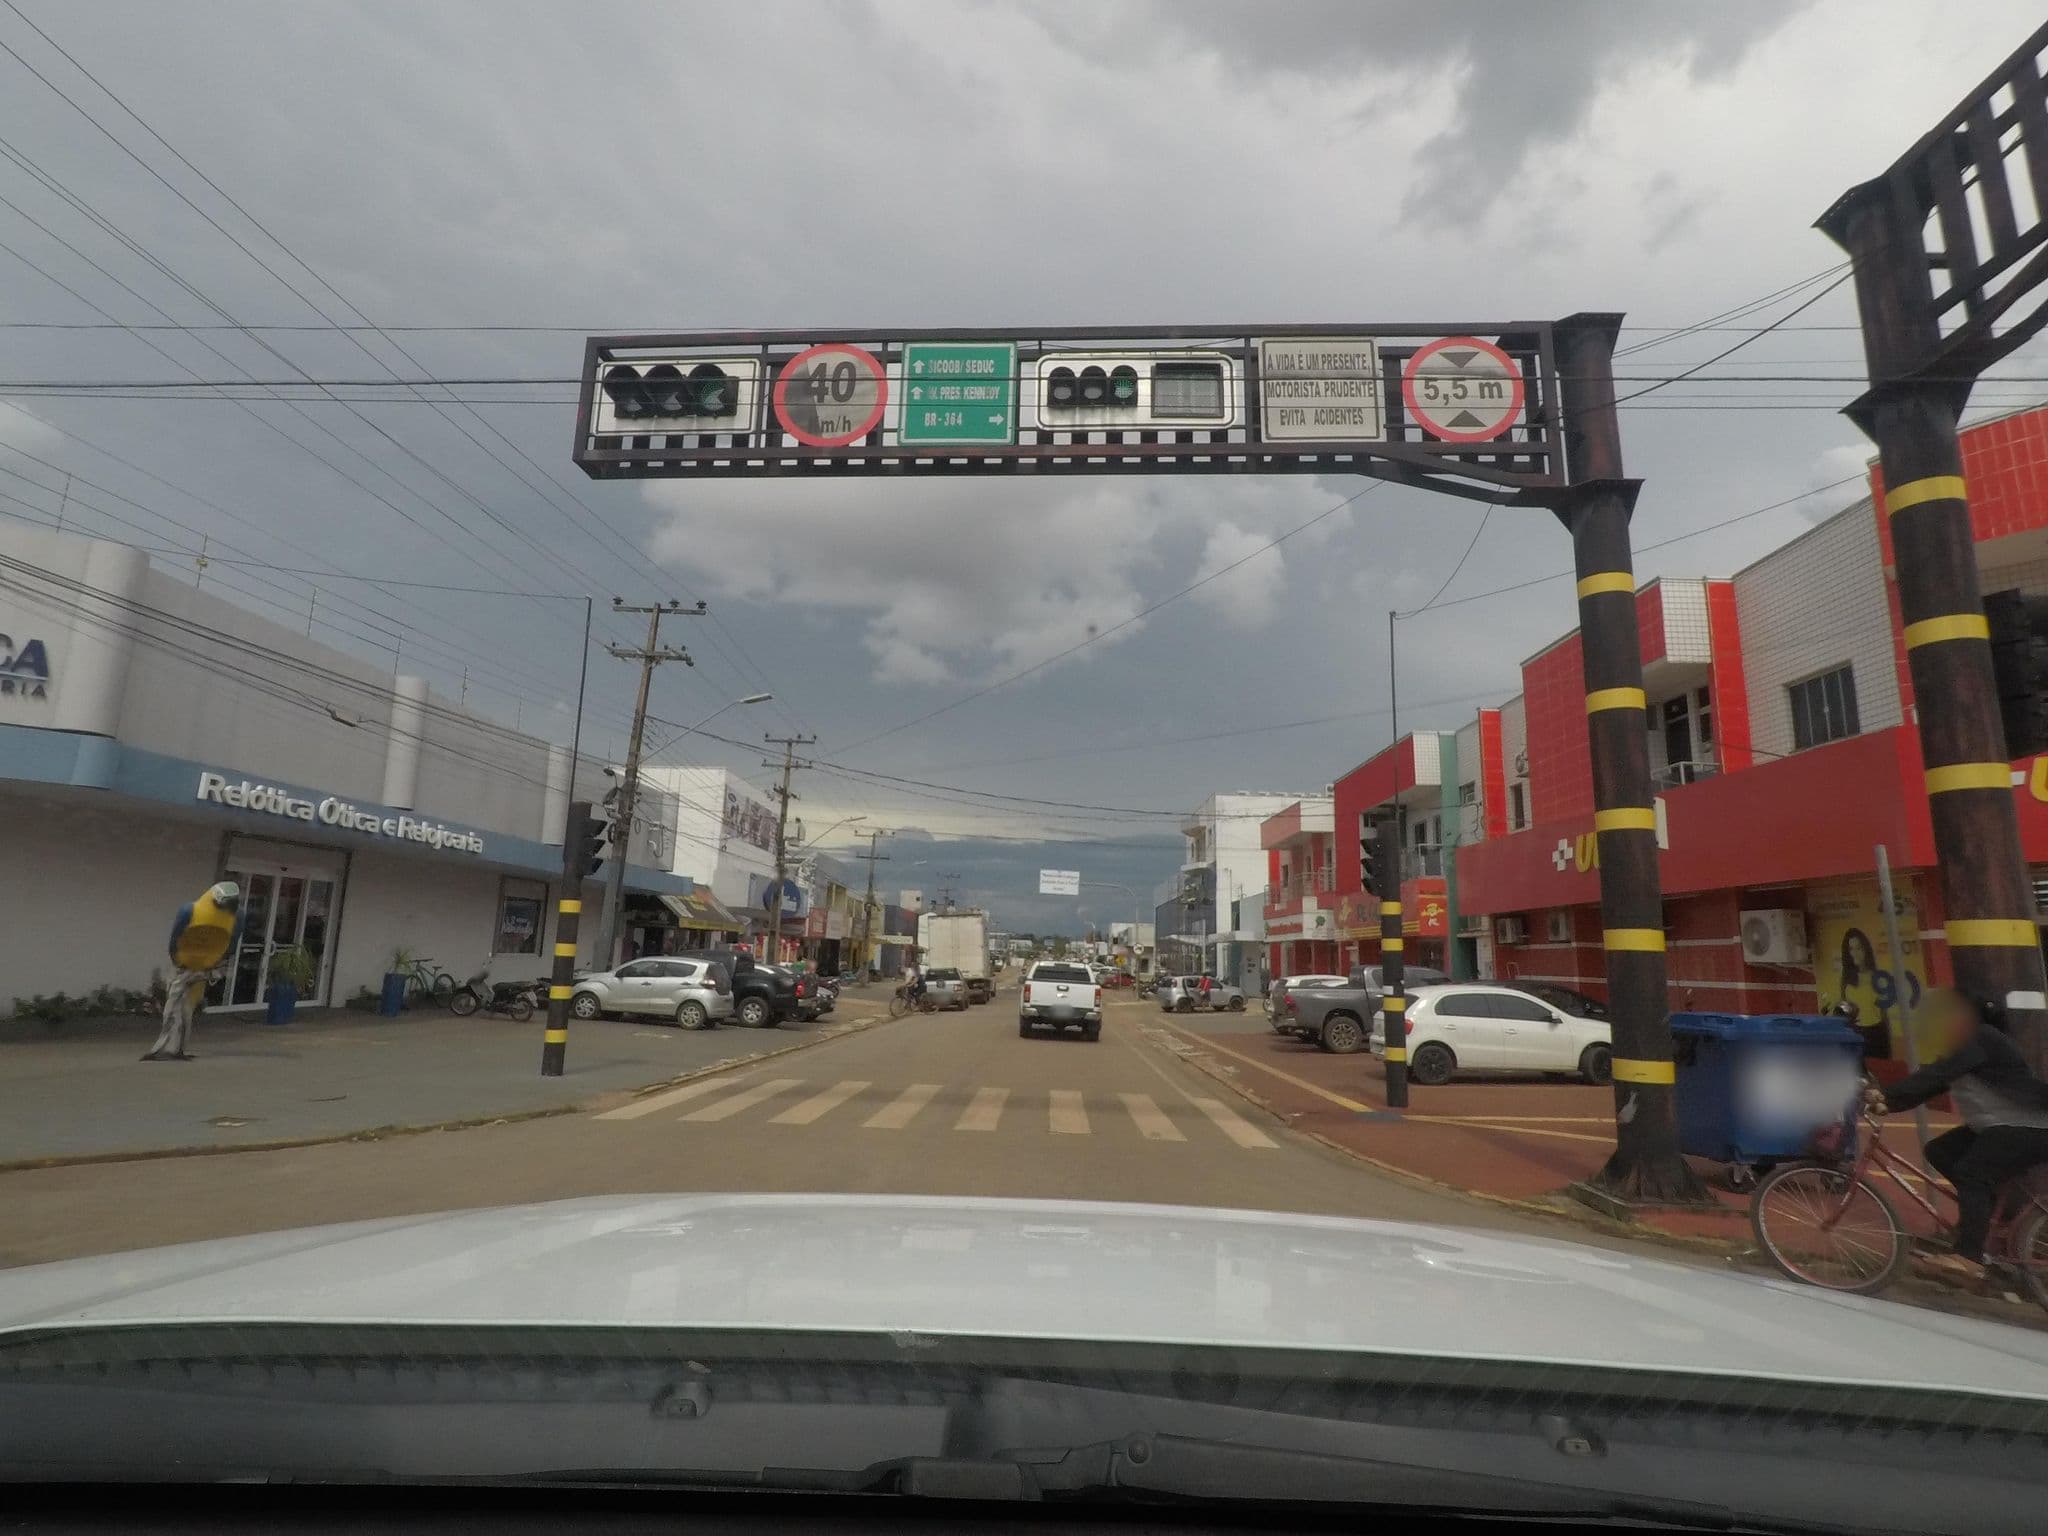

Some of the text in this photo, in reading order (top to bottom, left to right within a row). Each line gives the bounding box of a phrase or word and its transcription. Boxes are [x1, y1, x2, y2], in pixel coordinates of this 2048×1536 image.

[965, 359, 995, 374] SEDUC
[1267, 355, 1274, 370] A
[1274, 354, 1297, 370] VIDA
[1297, 349, 1304, 370] É
[1305, 354, 1320, 370] UM
[808, 361, 856, 403] 40
[1267, 380, 1374, 398] MOTORISTA PRUDENTE
[1423, 379, 1504, 405] 5,5 m
[1280, 408, 1364, 426] EVITA ACIDENTES
[196, 771, 314, 821] Relótica
[318, 797, 380, 834] Ótica
[382, 818, 397, 836] e
